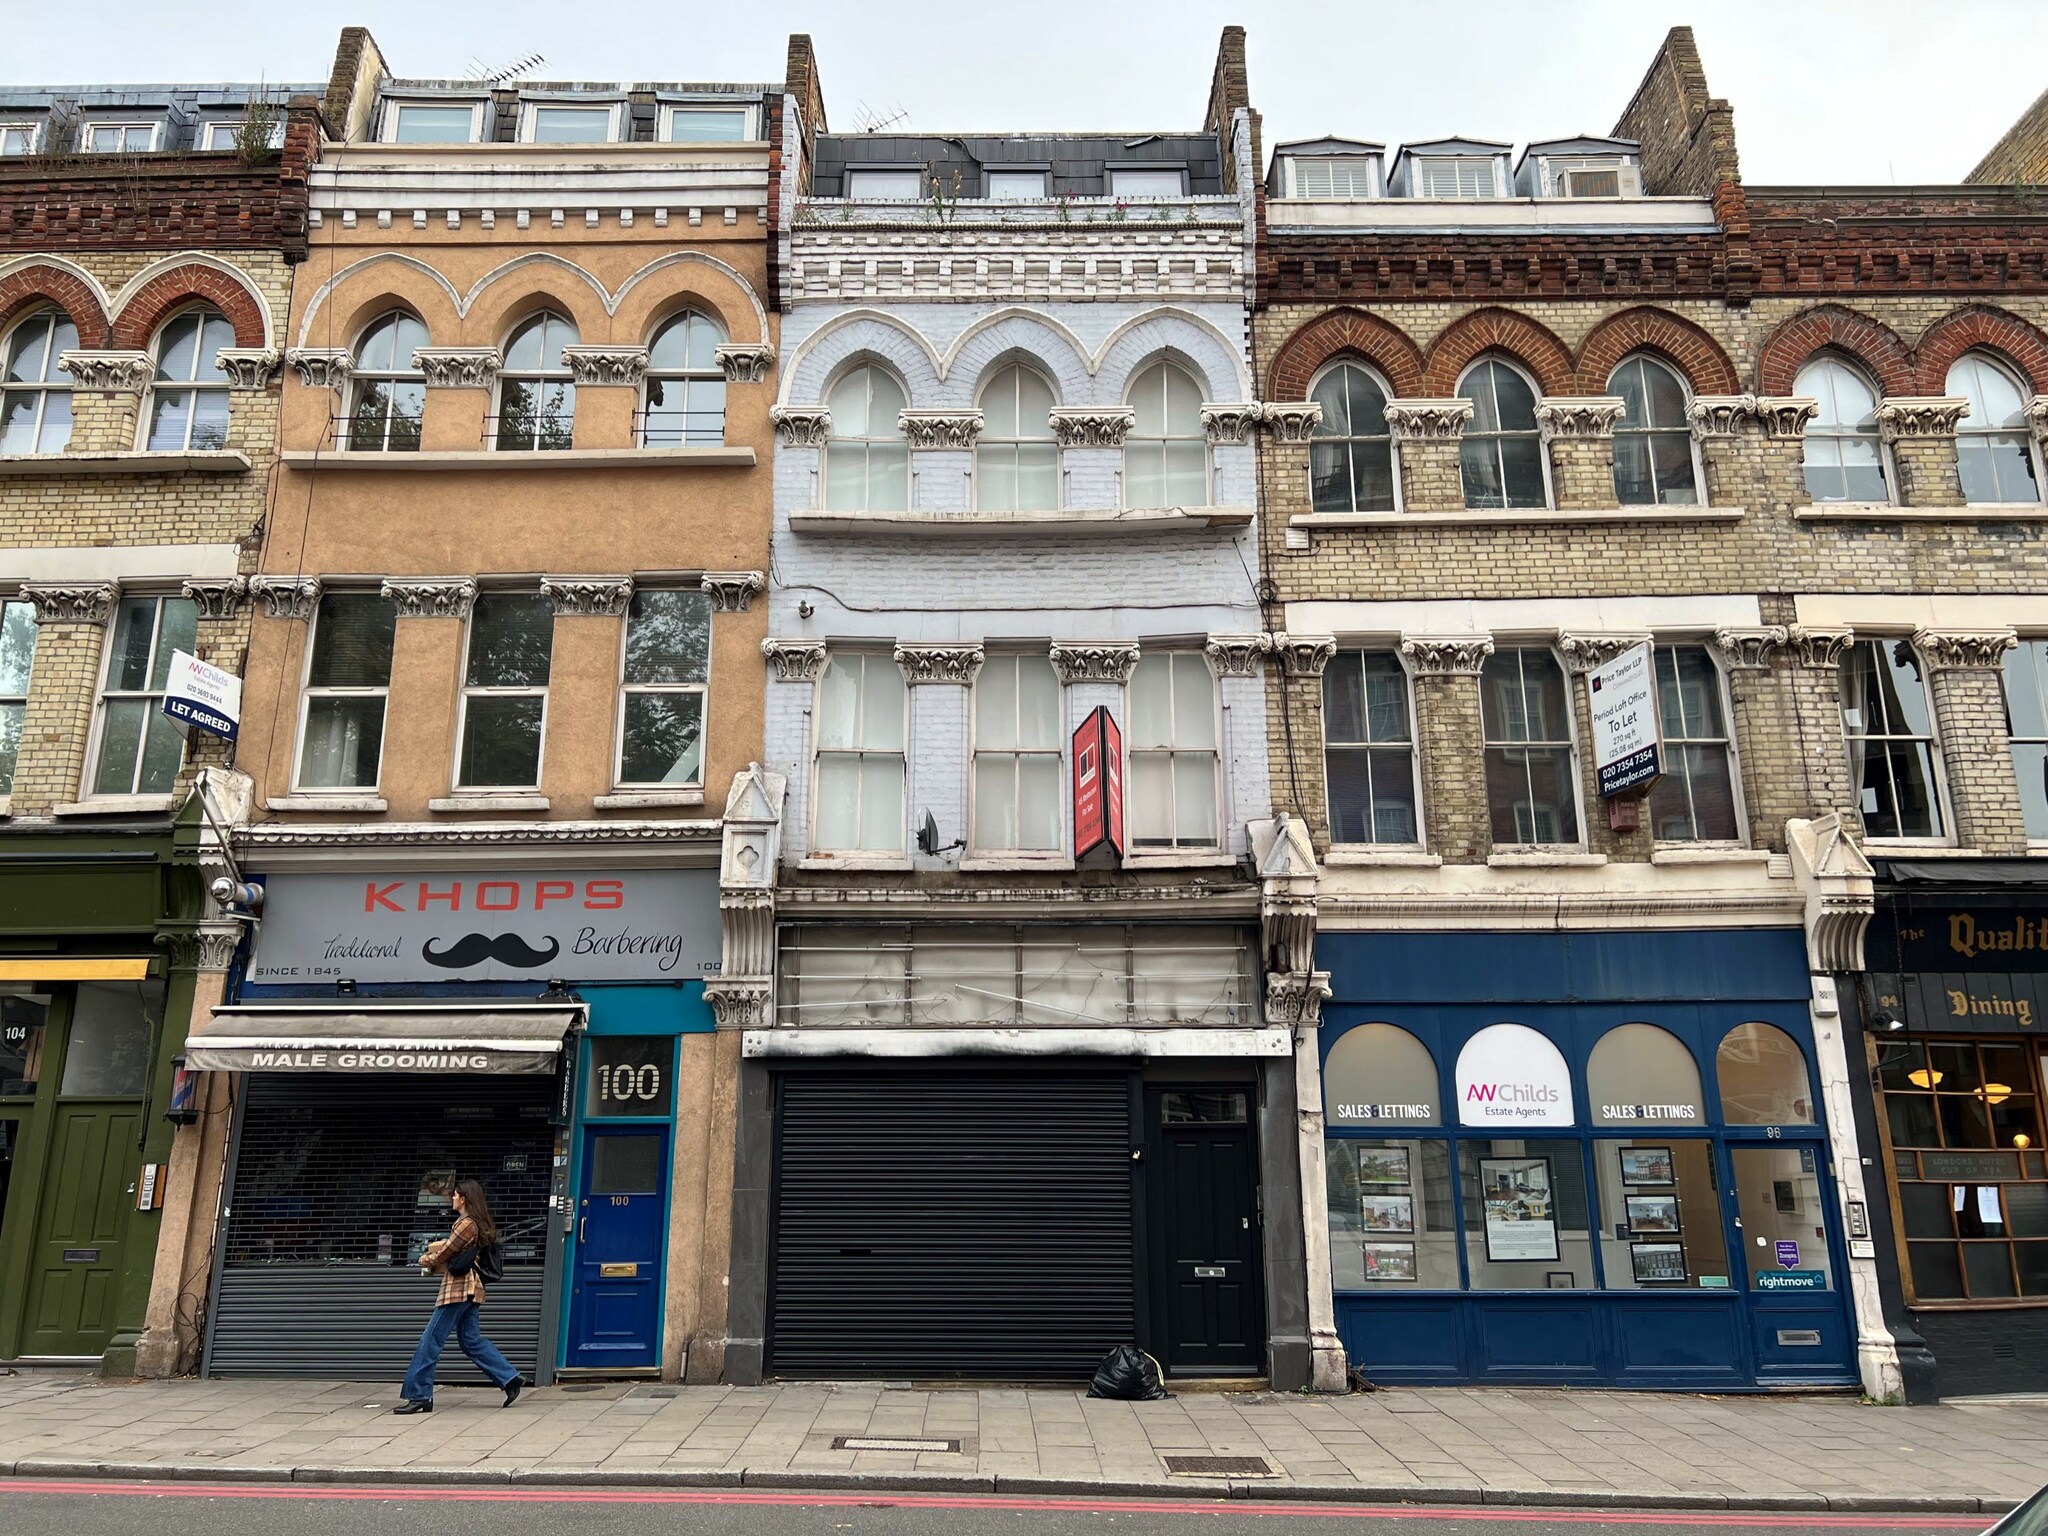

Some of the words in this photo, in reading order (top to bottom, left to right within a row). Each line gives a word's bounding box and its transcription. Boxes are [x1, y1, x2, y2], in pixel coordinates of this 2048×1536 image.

[1602, 673, 1615, 685] Price
[1615, 664, 1632, 676] Taylor
[1632, 656, 1642, 668] LLP
[1594, 705, 1614, 722] Period
[1614, 699, 1627, 712] Loft
[1627, 690, 1647, 705] Office
[171, 701, 190, 716] LET
[190, 709, 231, 732] AGREED
[1608, 719, 1620, 733] To
[1622, 711, 1637, 727] Let
[1613, 734, 1624, 745] 270
[1602, 765, 1616, 779] 020
[1616, 757, 1634, 773] 7354
[1634, 748, 1653, 765] 7354
[1604, 765, 1654, 792] Pricetaylor.com
[365, 880, 624, 912] KHOPS
[571, 925, 682, 971] Barbering
[256, 967, 298, 976] SINCE
[307, 967, 341, 976] 1845
[697, 962, 722, 971] 100
[1880, 994, 1899, 1008] 94
[1947, 989, 2033, 1026] Dining
[5, 1026, 26, 1040] 104
[251, 1053, 328, 1067] MALE
[338, 1054, 489, 1069] GROOMING
[598, 1063, 660, 1100] 100
[1497, 1084, 1559, 1103] Childs
[1485, 1106, 1513, 1116] Estate
[1515, 1106, 1546, 1119] Agents
[1766, 1126, 1782, 1139] 96
[610, 1195, 630, 1207] 100
[1759, 1275, 1815, 1290] rightmove
